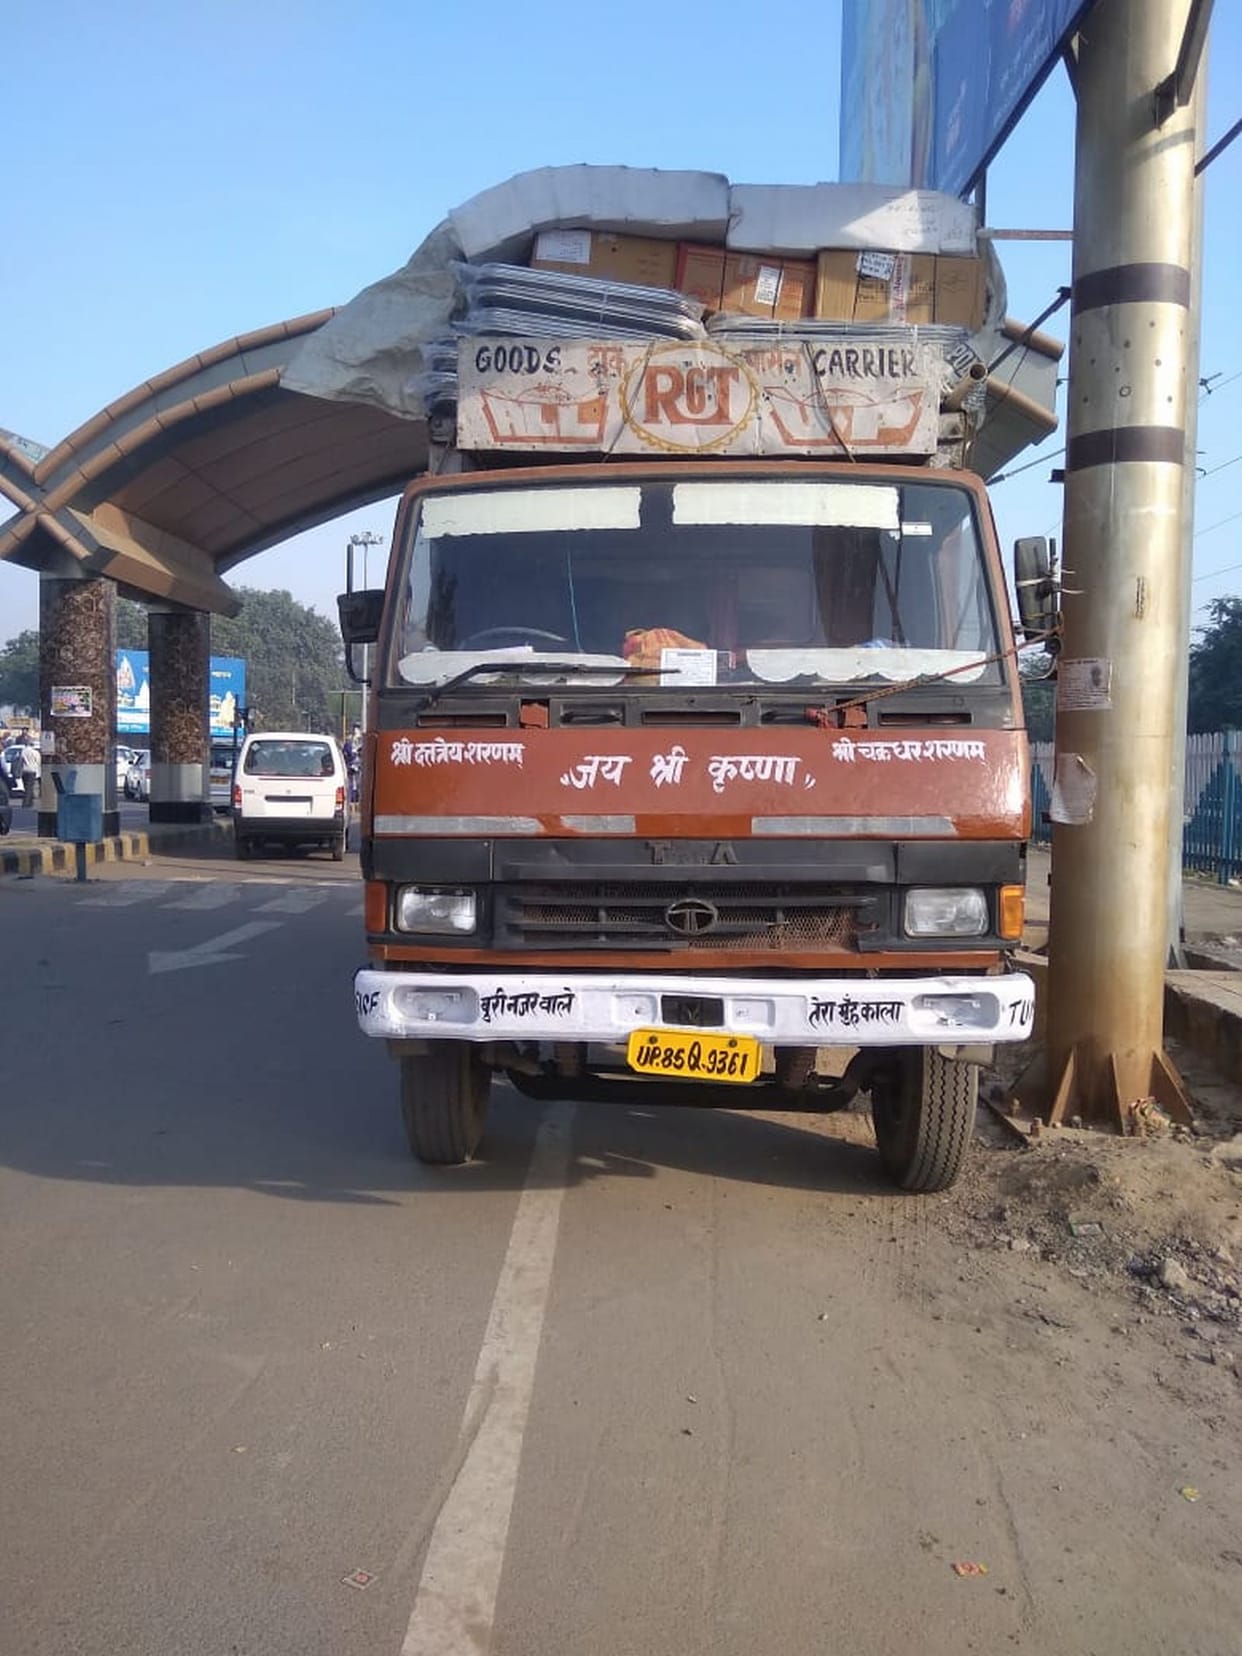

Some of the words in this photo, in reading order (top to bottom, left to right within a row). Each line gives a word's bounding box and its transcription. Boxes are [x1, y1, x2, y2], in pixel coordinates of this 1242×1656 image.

[475, 344, 562, 374] GOODS
[813, 347, 920, 379] CARRIER
[390, 737, 414, 766] श्री
[830, 737, 856, 762] श्री
[650, 746, 690, 788] श्री
[540, 987, 576, 1017] वाले
[809, 996, 837, 1030] तेरा
[861, 1000, 906, 1026] काला
